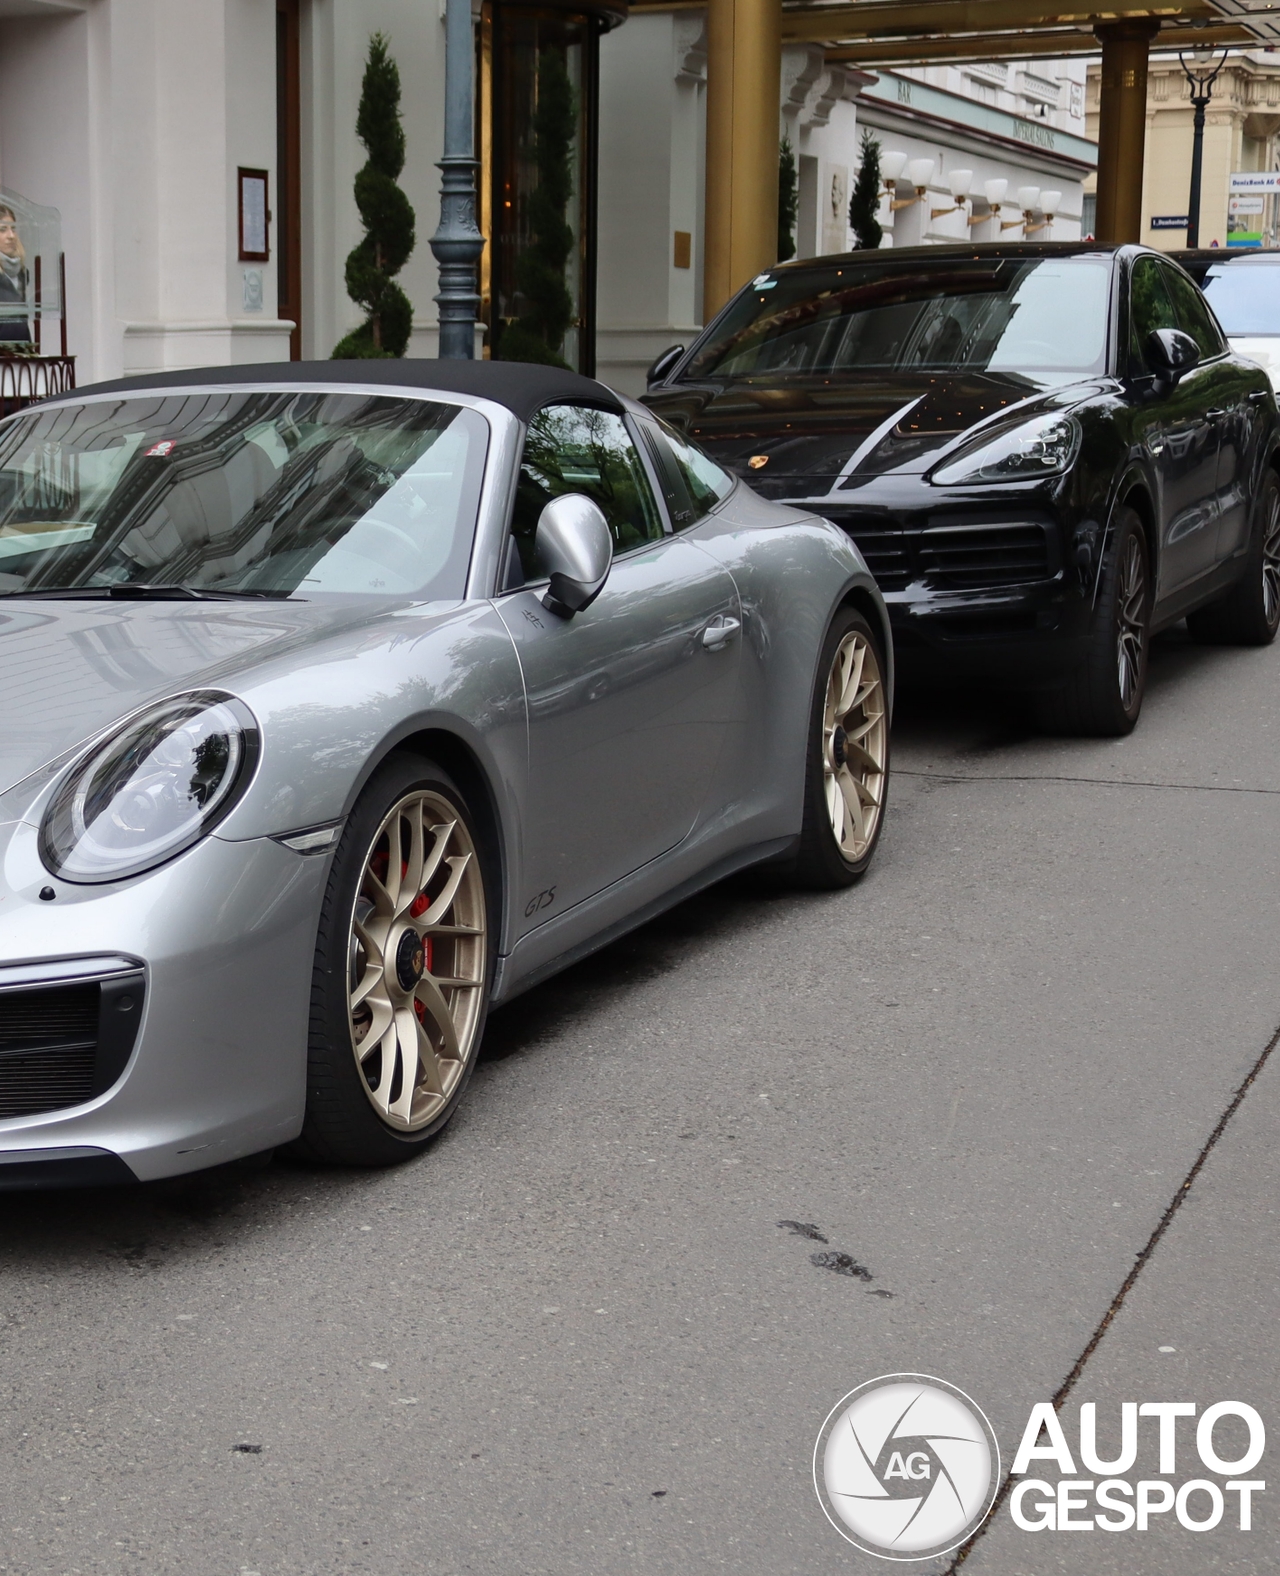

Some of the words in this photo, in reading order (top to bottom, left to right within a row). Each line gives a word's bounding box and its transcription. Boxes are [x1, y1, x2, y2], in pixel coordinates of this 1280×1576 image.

[897, 80, 912, 104] BAR
[1013, 118, 1036, 144] IMPERIAL
[524, 885, 557, 918] GTS
